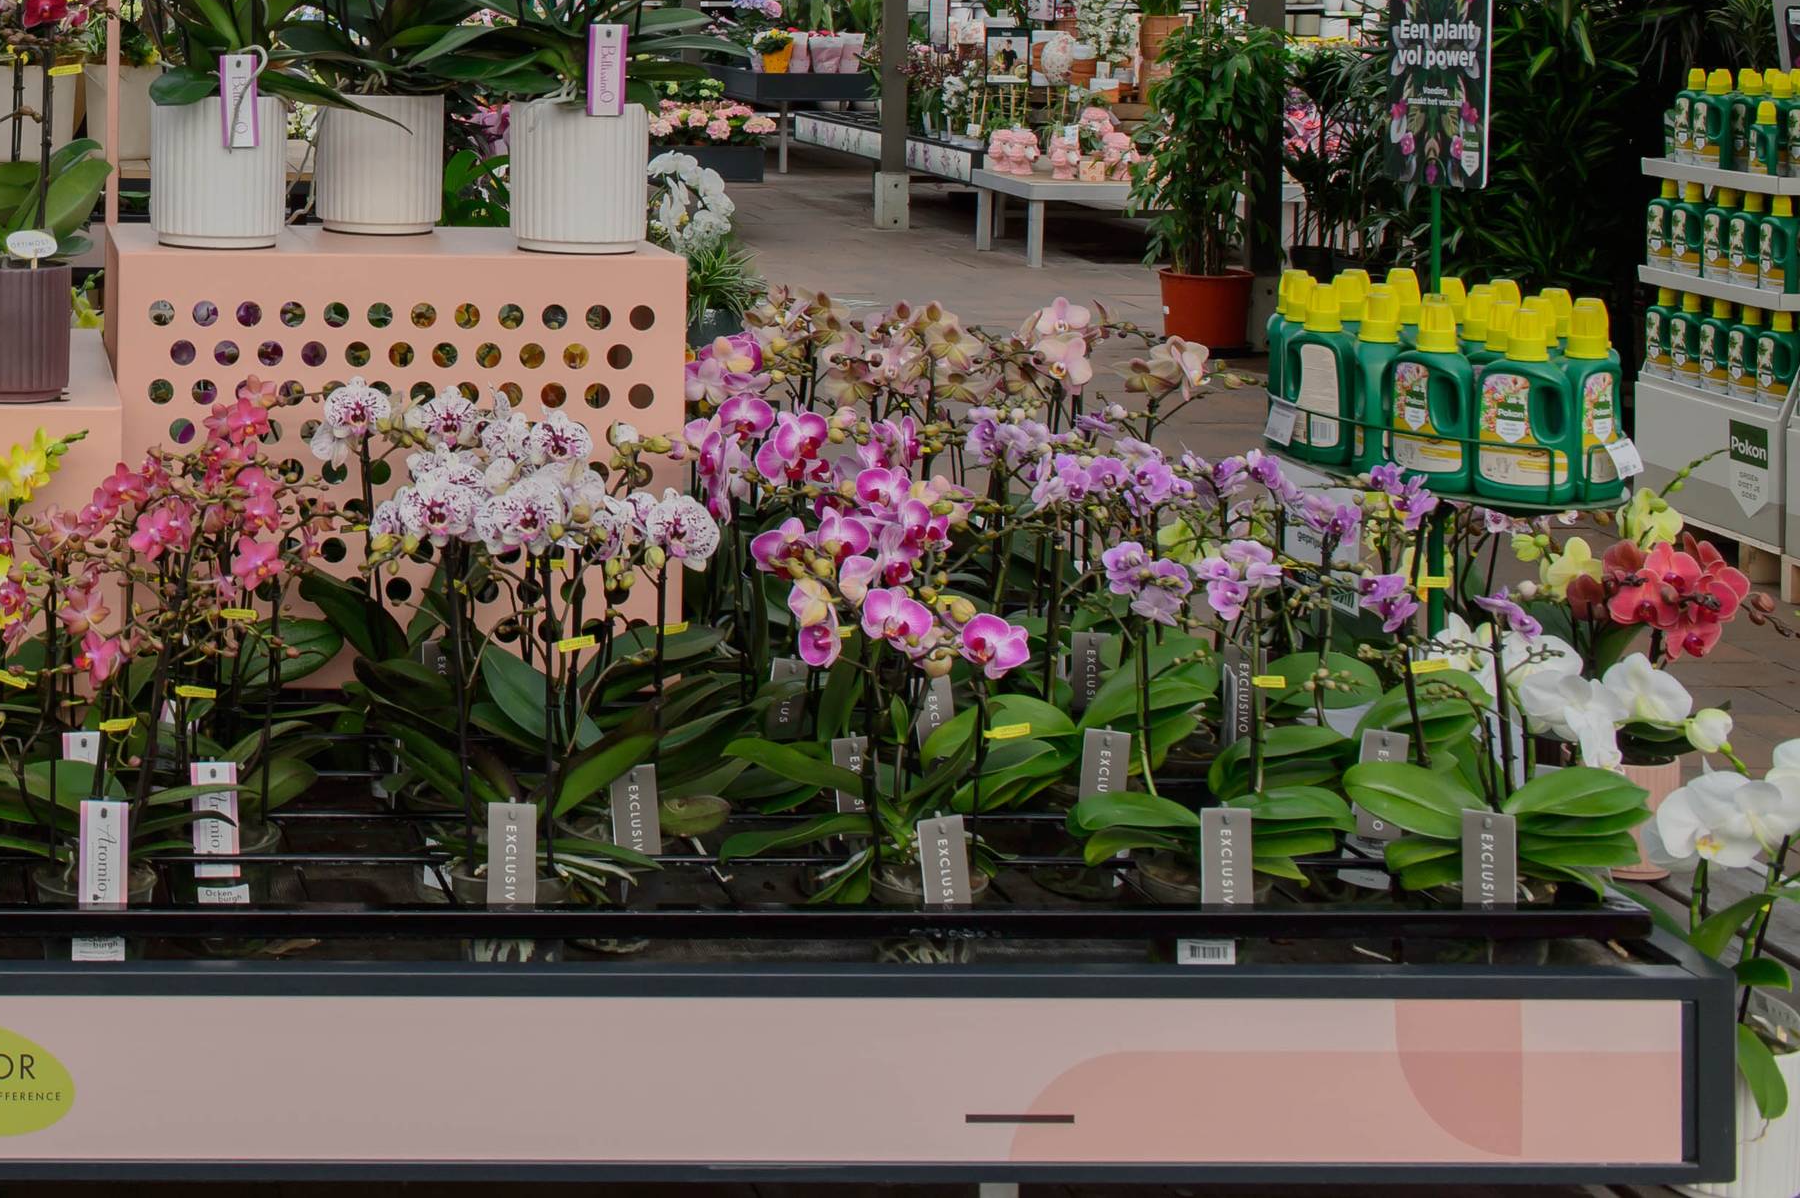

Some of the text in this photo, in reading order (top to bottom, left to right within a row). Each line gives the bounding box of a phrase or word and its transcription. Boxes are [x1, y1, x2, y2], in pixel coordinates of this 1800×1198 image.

[1400, 19, 1475, 43] Een plant
[1398, 46, 1476, 69] vol power
[1497, 407, 1525, 419] Pokon
[1731, 435, 1767, 461] Pokon
[1086, 649, 1098, 702] EXCLUSI
[1238, 662, 1249, 733] EXCLUSIVO
[1098, 751, 1112, 793] EXCLU
[628, 785, 644, 852] EXCLUSIV
[98, 824, 118, 893] Aromio
[504, 825, 517, 902] EXCLUSIV
[938, 838, 953, 903] EXCLUSI
[1221, 828, 1234, 904] EXCLUSIV
[1481, 833, 1495, 905] EXCLUSI
[205, 889, 233, 898] Ocken
[217, 894, 243, 903] burgh
[92, 940, 119, 949] burgh
